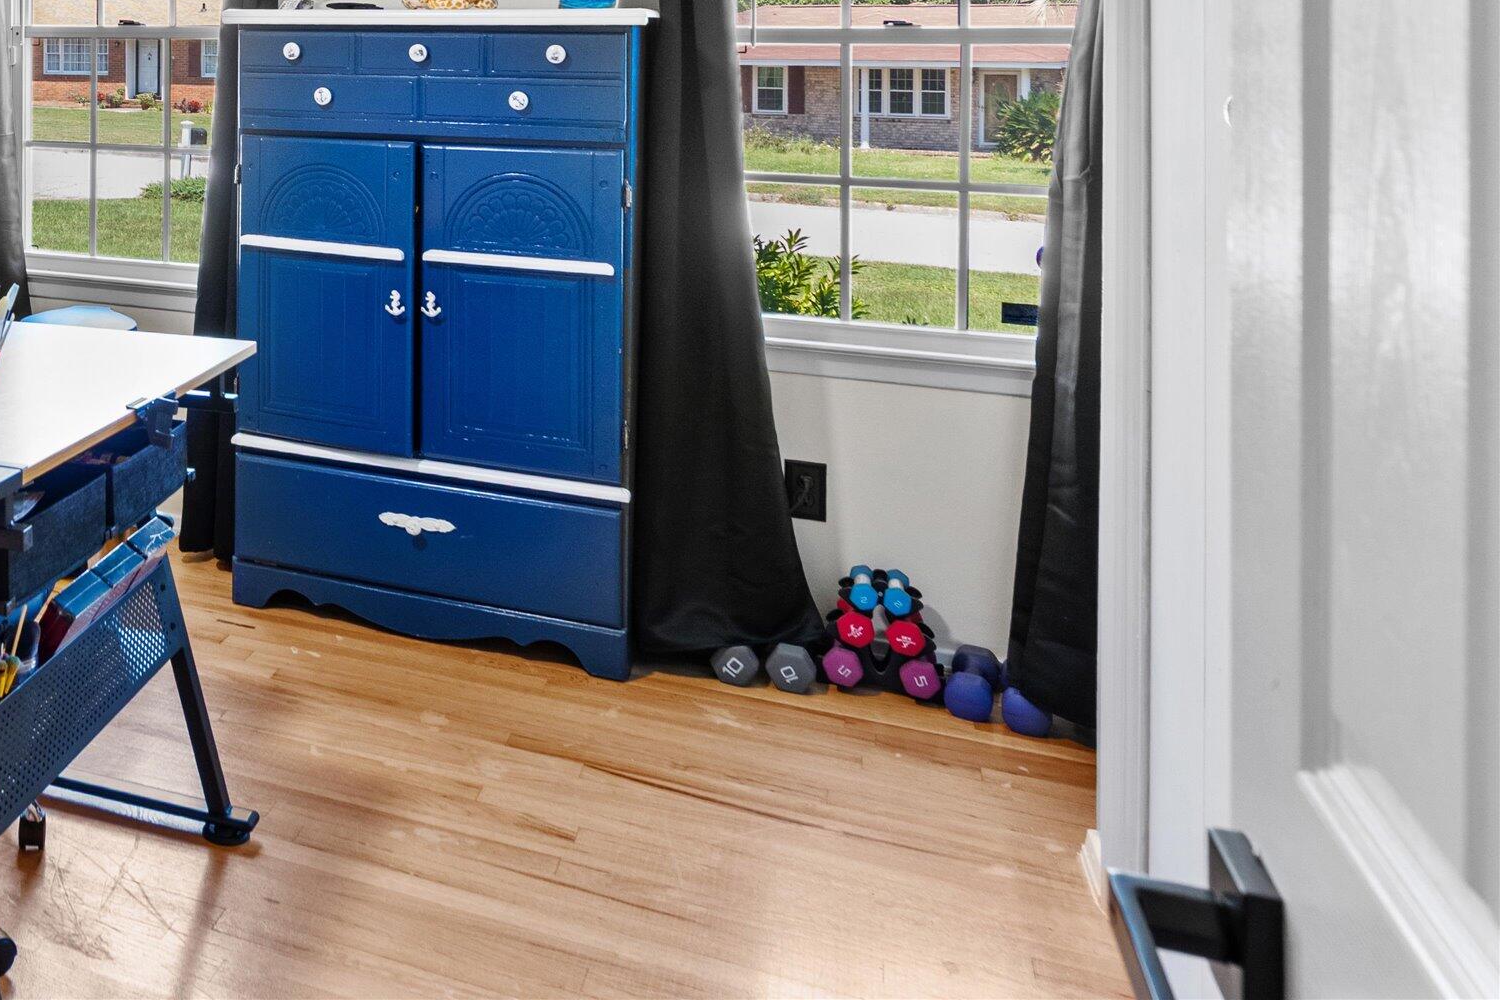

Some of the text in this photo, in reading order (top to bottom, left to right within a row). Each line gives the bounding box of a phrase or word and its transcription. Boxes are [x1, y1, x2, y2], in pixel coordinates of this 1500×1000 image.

[722, 656, 745, 678] 10
[780, 665, 799, 685] 10
[837, 664, 852, 678] 5
[913, 675, 929, 688] 5
